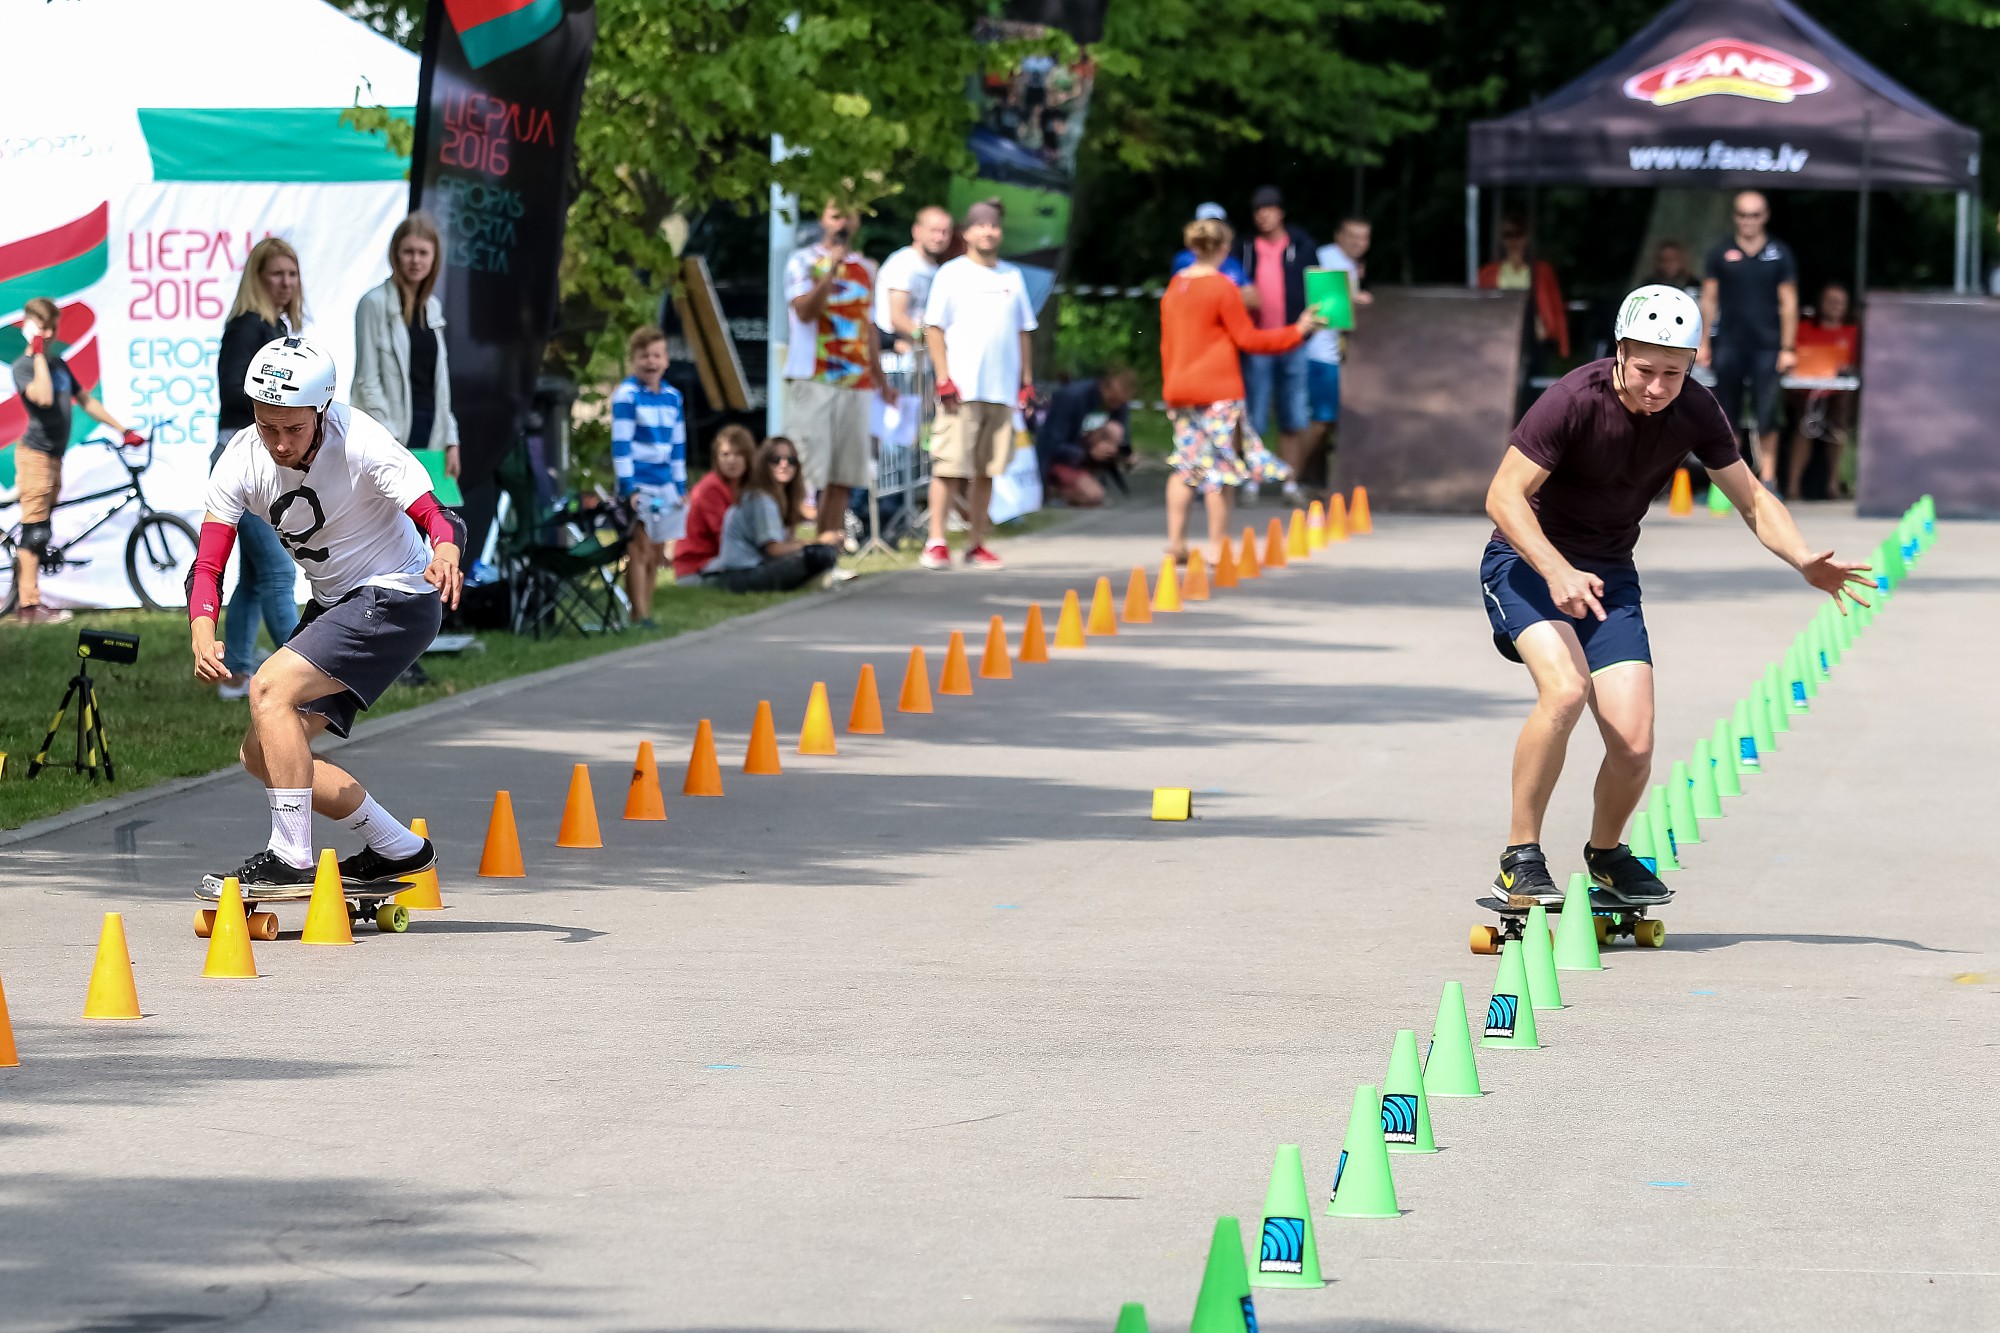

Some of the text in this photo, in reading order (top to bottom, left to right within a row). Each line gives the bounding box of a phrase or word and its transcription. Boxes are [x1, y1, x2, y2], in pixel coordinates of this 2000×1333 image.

[1661, 54, 1795, 88] FANS
[439, 126, 510, 176] 2016
[1629, 140, 1809, 172] www.fans.lv
[129, 278, 225, 321] 2016
